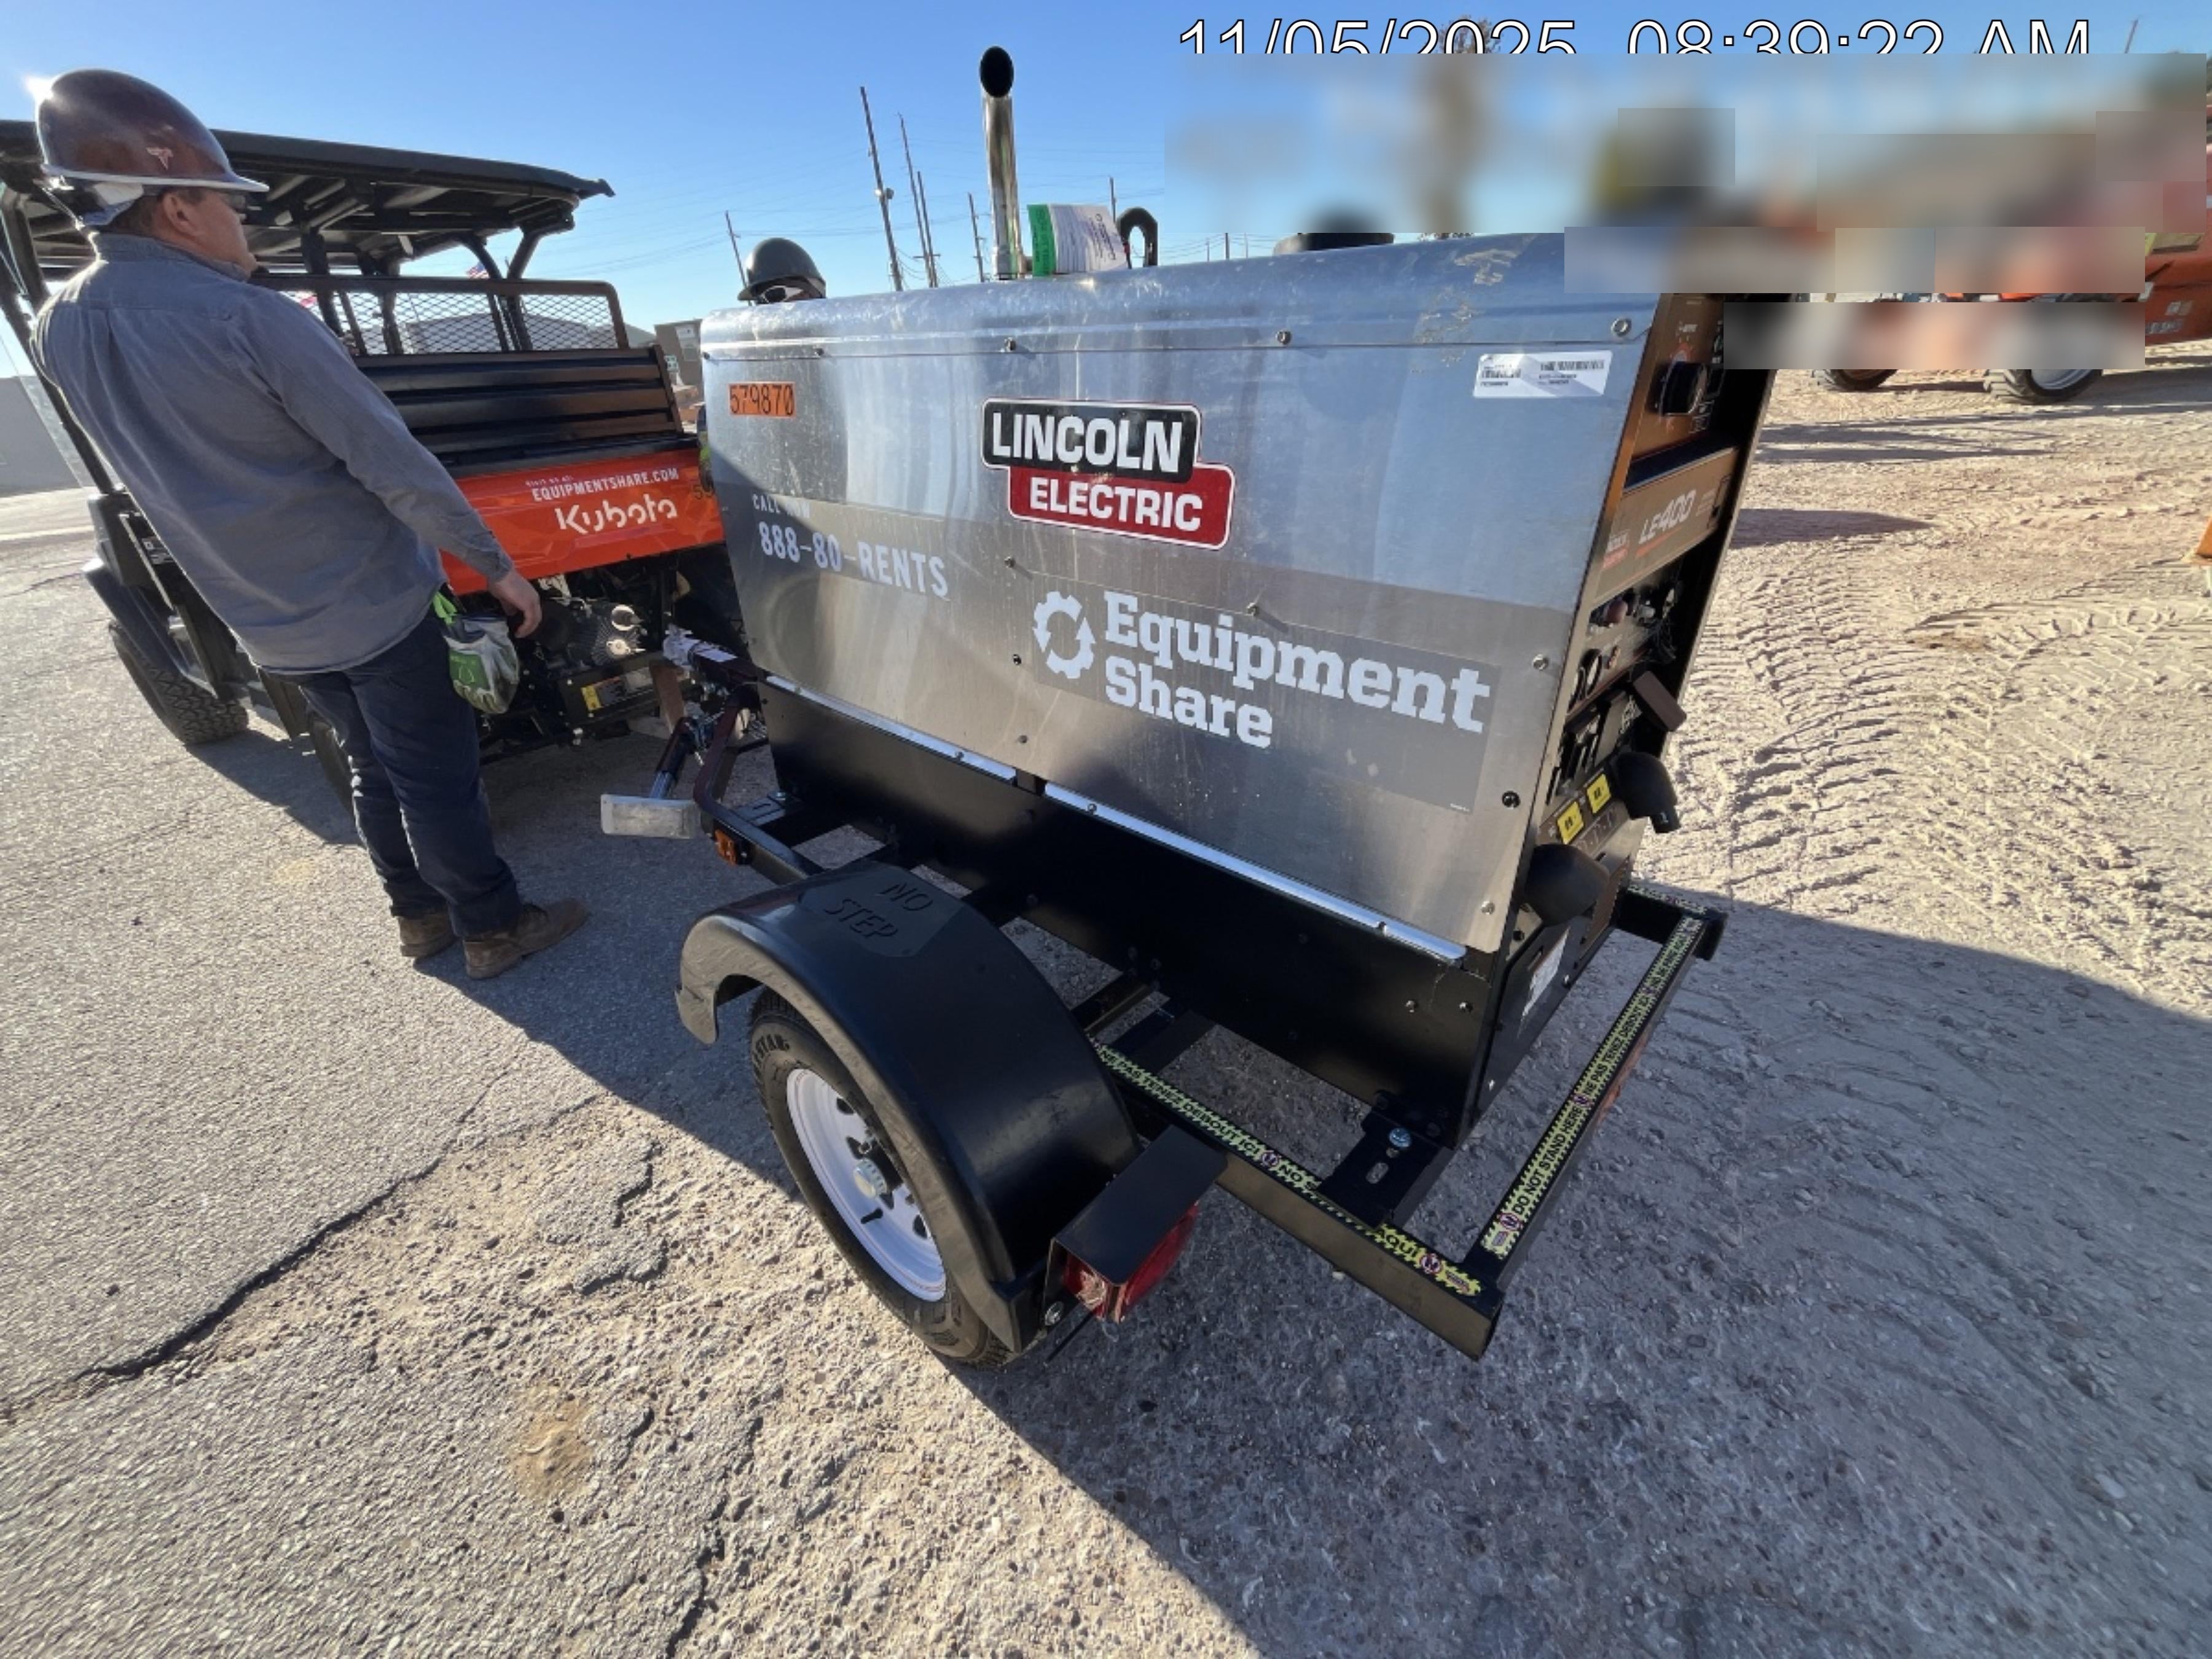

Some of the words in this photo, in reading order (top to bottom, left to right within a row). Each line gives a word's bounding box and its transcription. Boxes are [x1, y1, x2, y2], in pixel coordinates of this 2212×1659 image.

[992, 412, 1183, 473] LINCOLN
[531, 468, 679, 501] EQUIPMENTSHARE.COM
[752, 493, 781, 514] CALL
[1030, 477, 1202, 531] ELECTRIC
[554, 494, 678, 535] Kubota
[759, 522, 950, 597] 888-80-RENTS
[1104, 590, 1490, 732] Equipment
[1105, 655, 1273, 749] Share
[824, 898, 898, 938] STEP
[876, 883, 933, 911] NO
[1183, 1103, 1237, 1139] DEBOUT
[1238, 1140, 1261, 1155] ICI
[1279, 1164, 1303, 1182] NO
[1512, 1196, 1531, 1215] DO
[1524, 1170, 1547, 1195] NOT
[1539, 1133, 1566, 1171] STAND
[1559, 1107, 1583, 1132] HERE
